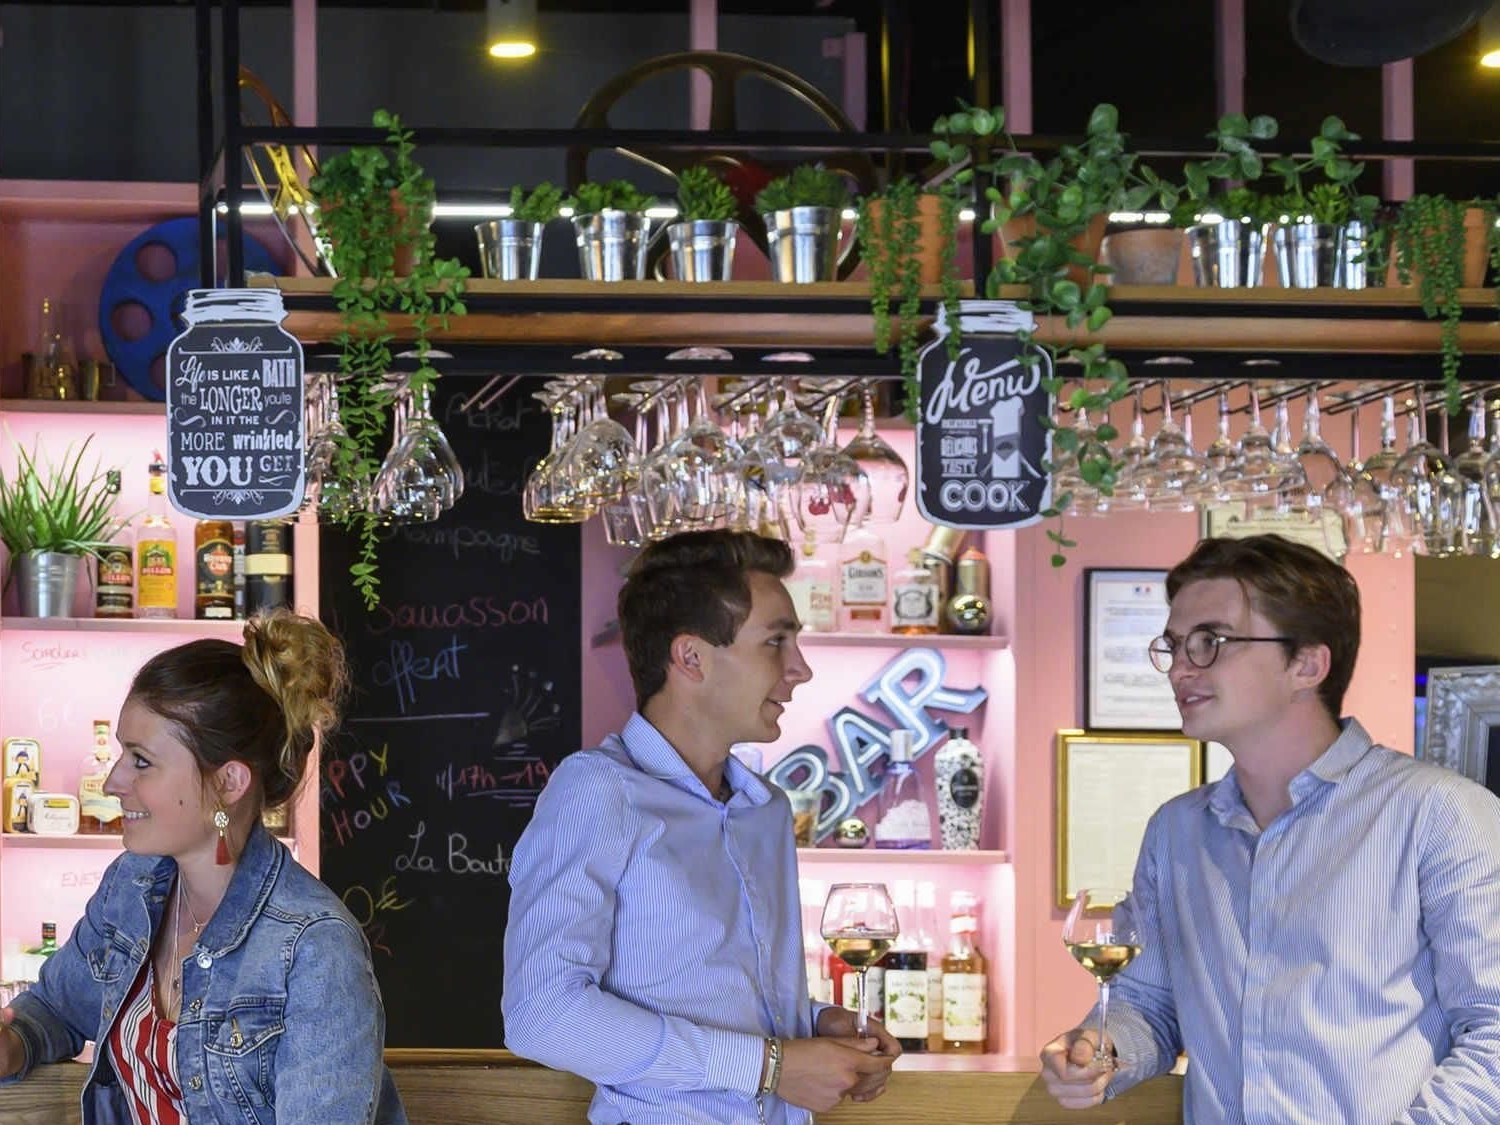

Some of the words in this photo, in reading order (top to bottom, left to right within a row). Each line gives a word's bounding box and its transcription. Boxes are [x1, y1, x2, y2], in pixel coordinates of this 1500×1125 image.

[175, 355, 206, 394] Life
[207, 370, 219, 381] IS
[222, 370, 249, 381] LIKE
[251, 370, 261, 381] A
[262, 358, 296, 388] BATH
[925, 347, 1041, 425] Menu
[180, 393, 197, 406] the
[199, 385, 263, 414] LONGER
[211, 416, 223, 425] IN
[226, 416, 237, 425] IT
[240, 416, 260, 425] THE
[180, 432, 226, 451] MORE
[232, 427, 294, 451] wrinkled
[181, 455, 254, 487] YOU
[260, 455, 295, 473] GET
[939, 479, 1031, 513] COOK
[766, 647, 988, 845] BAR
